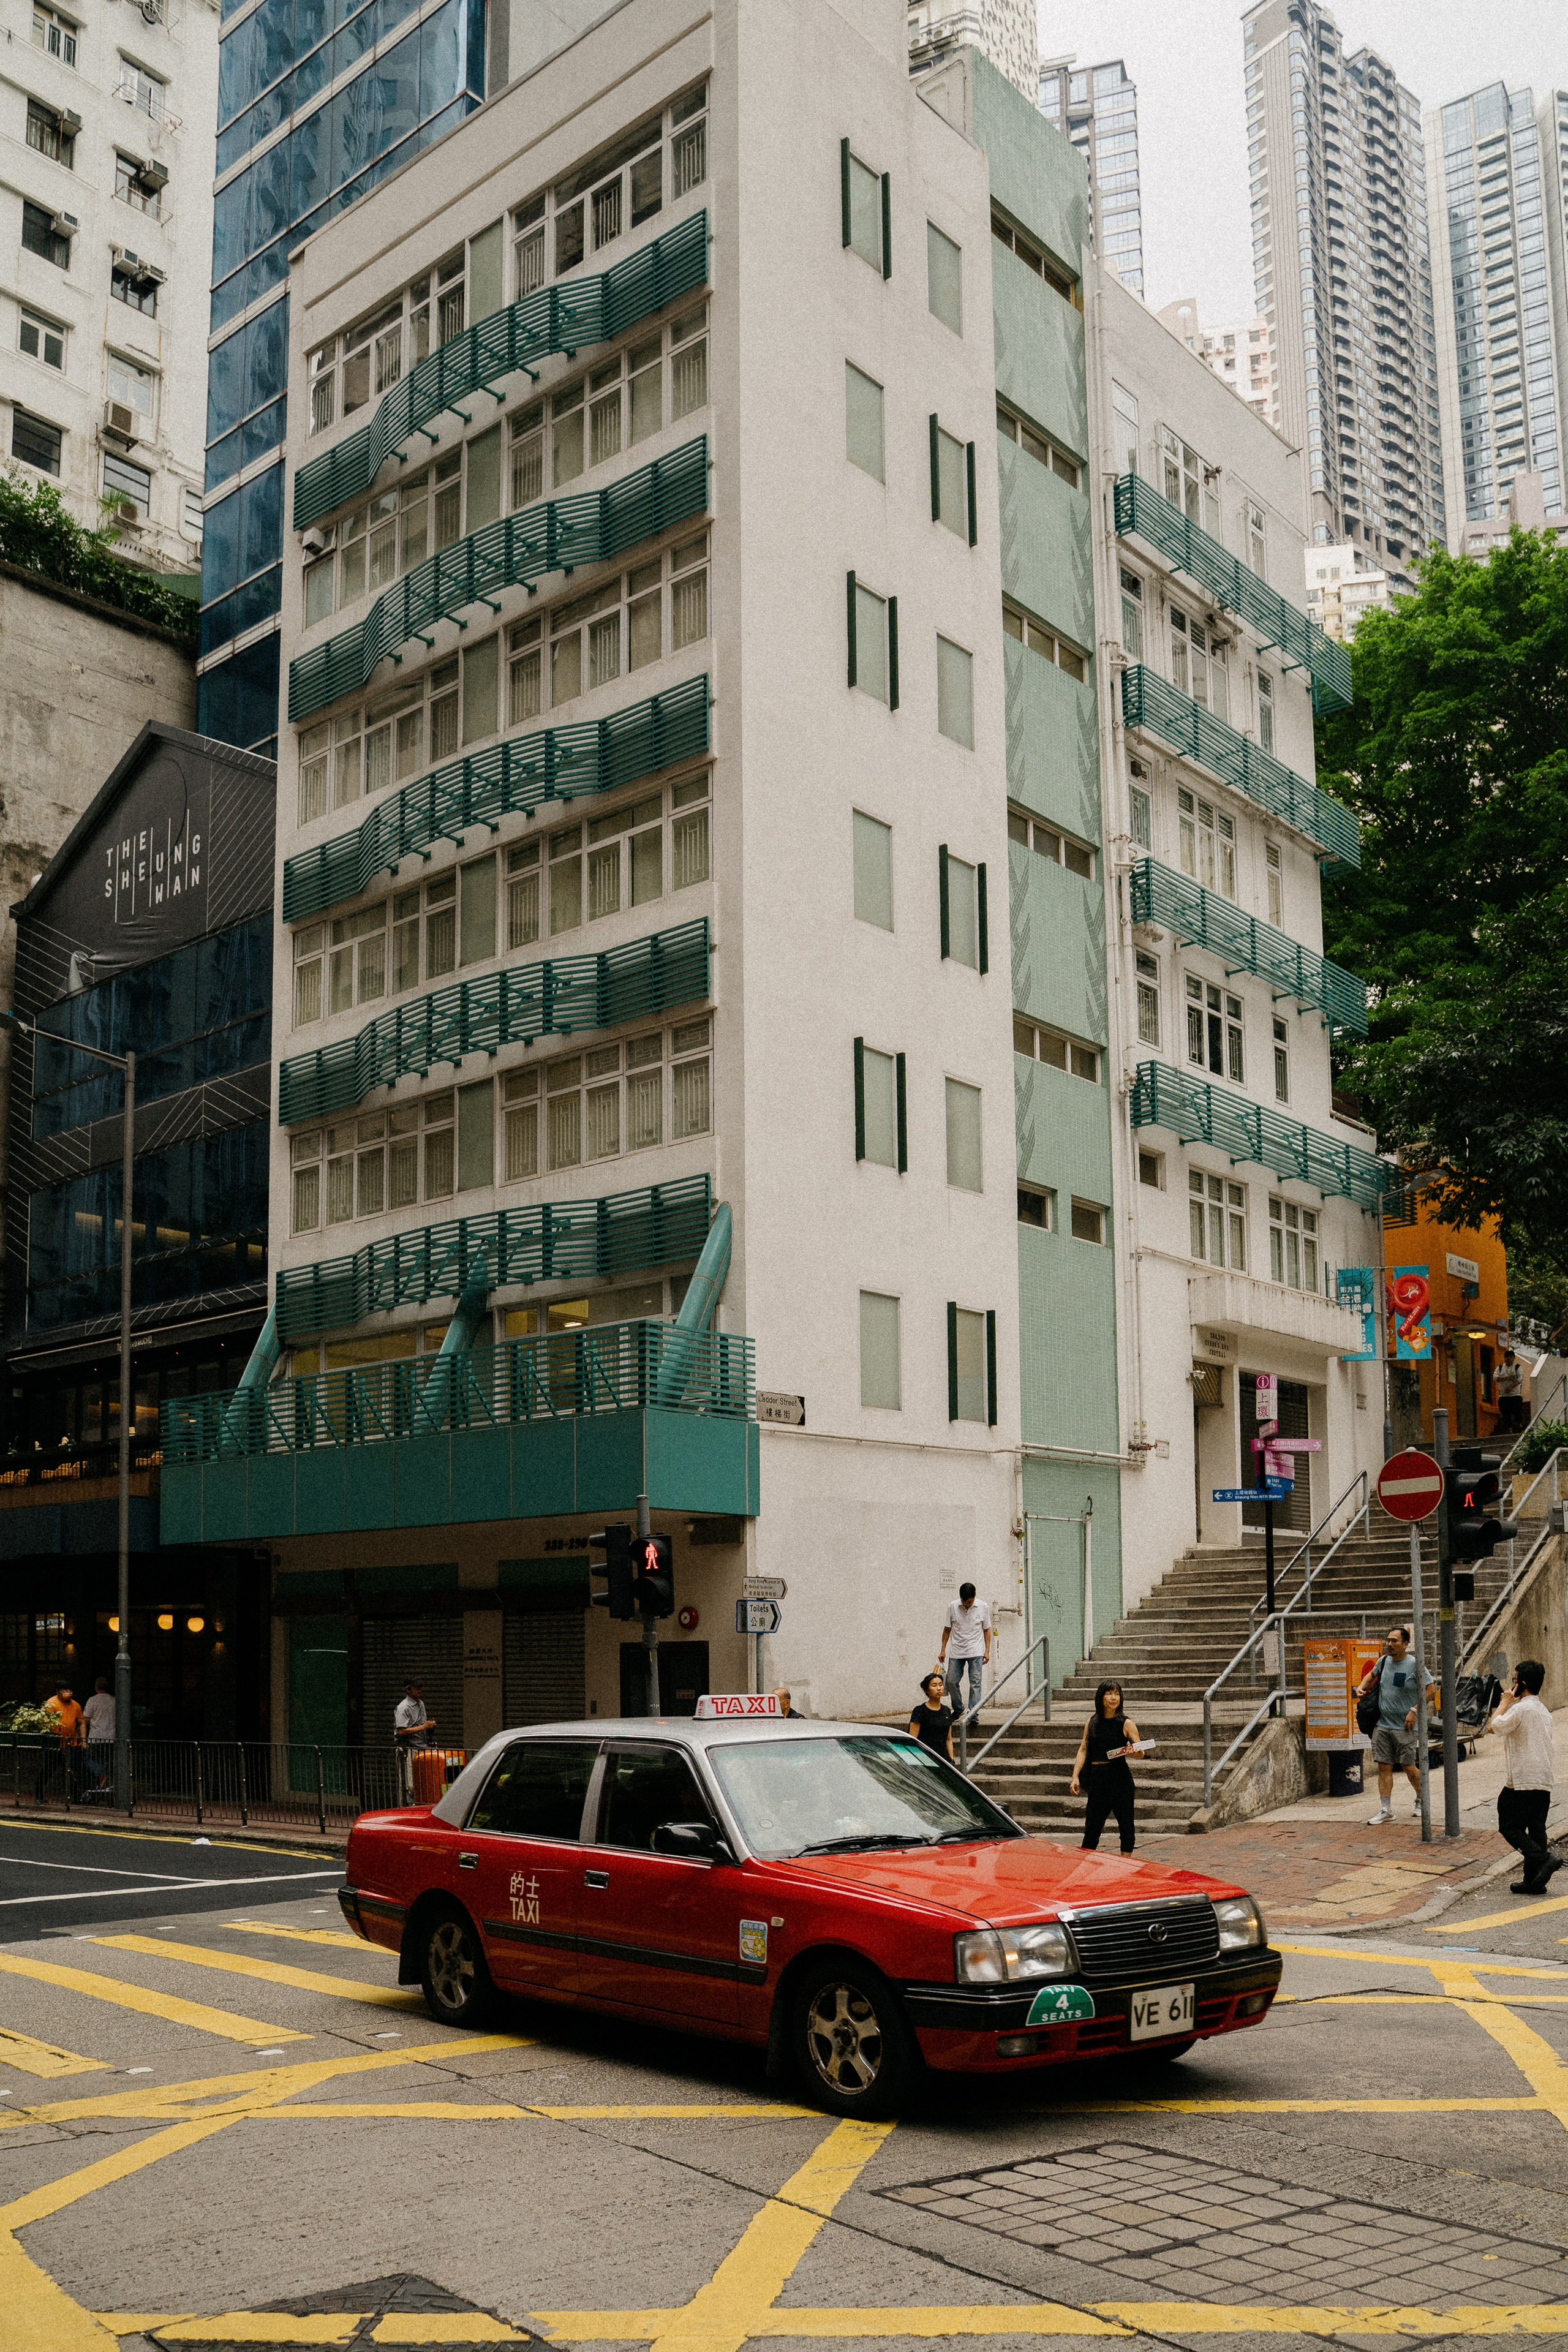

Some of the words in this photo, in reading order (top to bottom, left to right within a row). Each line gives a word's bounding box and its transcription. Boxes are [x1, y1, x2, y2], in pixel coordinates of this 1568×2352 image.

[107, 831, 146, 867] THE
[105, 834, 200, 897] SHEUNG
[156, 865, 200, 904] WAN
[758, 1395, 777, 1404] Ladder
[780, 1397, 797, 1407] Street
[766, 1408, 790, 1419] 樓梯街
[1257, 1392, 1268, 1417] 上環
[711, 1697, 776, 1714] TAXI
[510, 1872, 540, 1899] 的士
[510, 1896, 539, 1924] TAXI
[1046, 1986, 1074, 1994] TAXI
[1055, 1994, 1069, 2010] 4
[1041, 2010, 1082, 2021] SEATS
[1134, 2001, 1160, 2027] VE
[1169, 1996, 1193, 2021] 611
